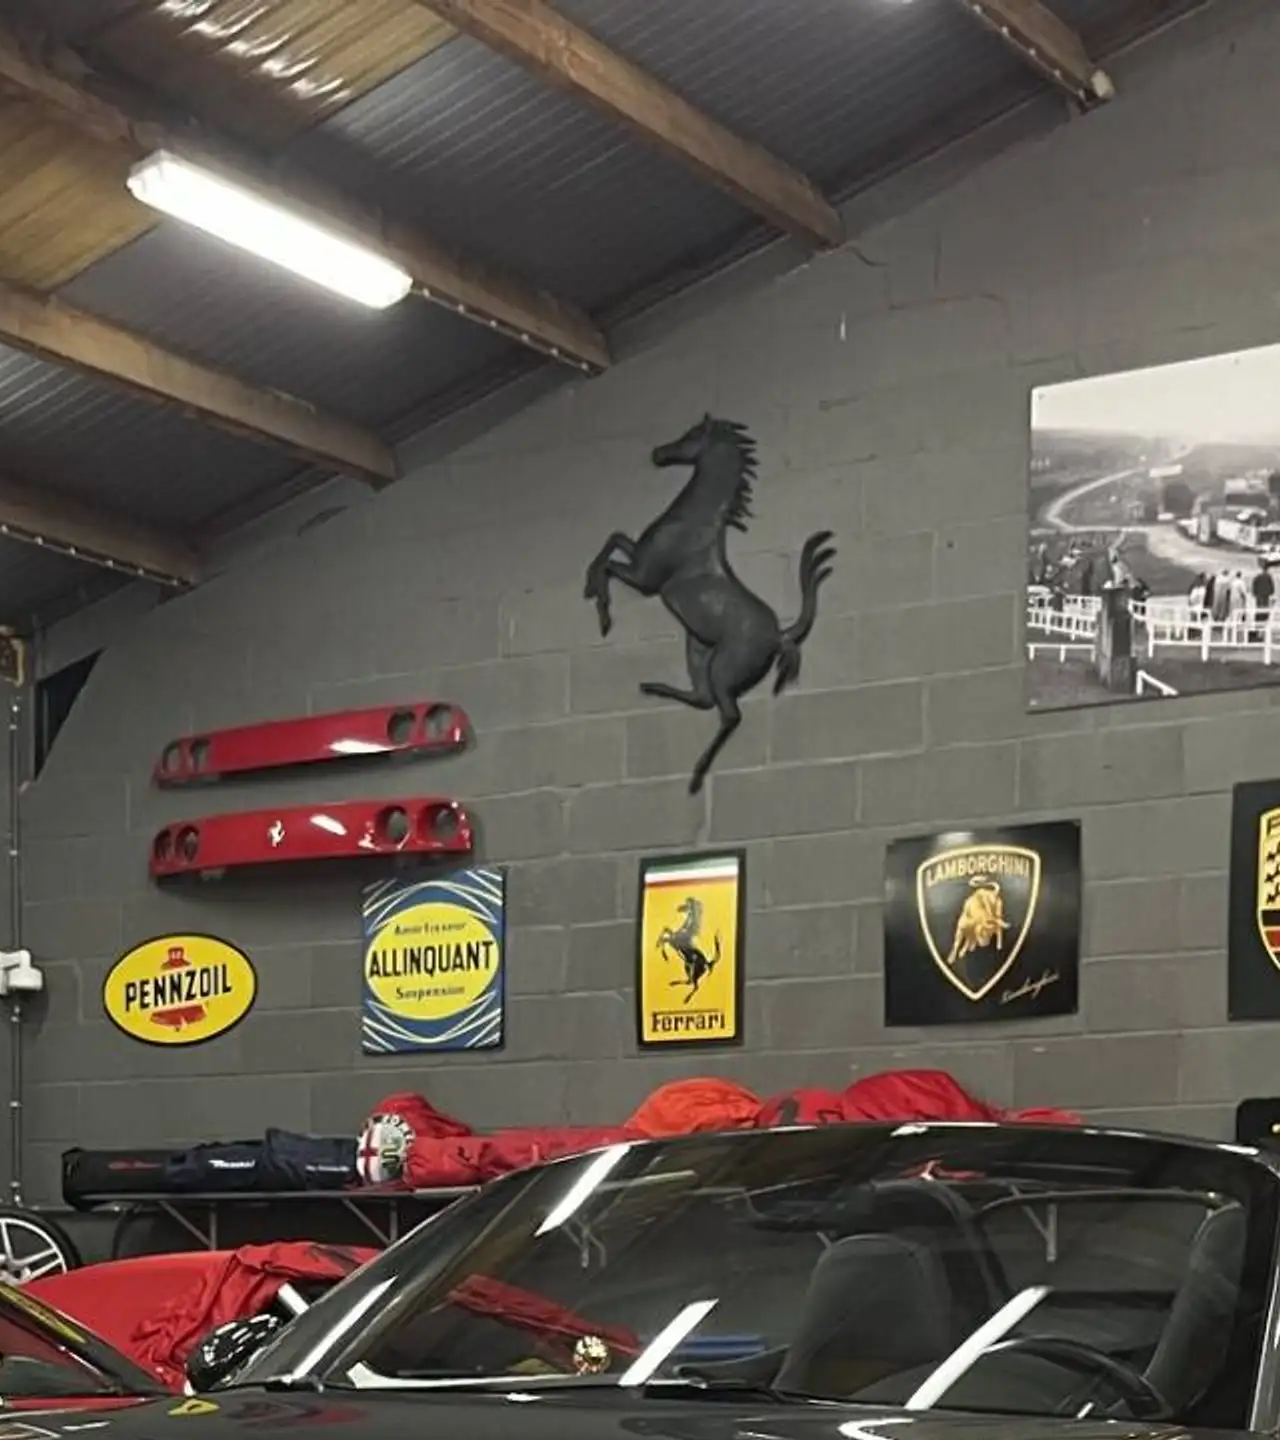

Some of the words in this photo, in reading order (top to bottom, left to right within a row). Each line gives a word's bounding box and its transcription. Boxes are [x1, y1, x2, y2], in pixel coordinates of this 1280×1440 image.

[926, 853, 1030, 888] LAMBORGHINI
[370, 940, 494, 978] ALLINQUANT
[124, 963, 233, 1012] PENNZOIL
[651, 1008, 725, 1033] Ferrari
